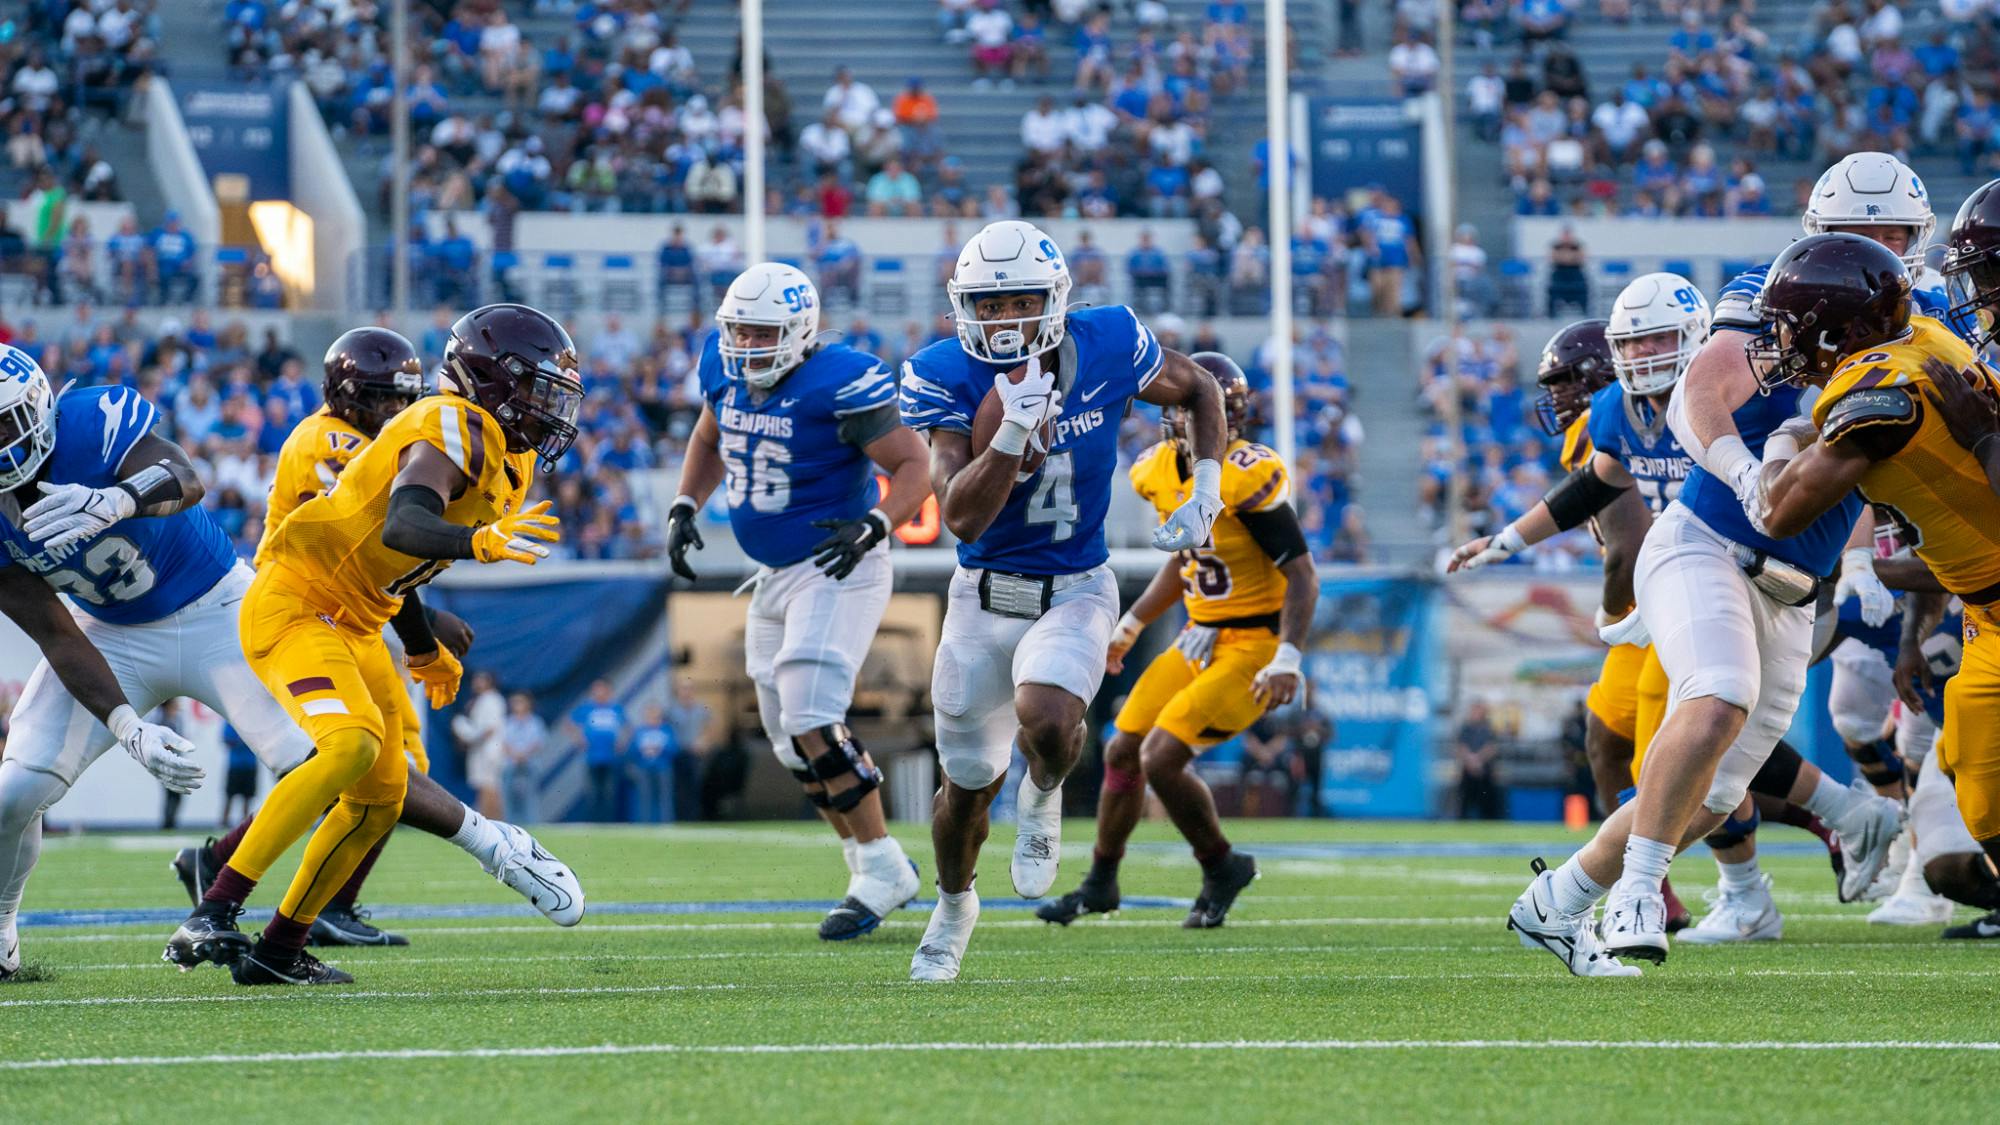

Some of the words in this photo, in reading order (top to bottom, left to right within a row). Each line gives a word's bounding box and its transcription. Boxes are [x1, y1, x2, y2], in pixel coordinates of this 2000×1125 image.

[325, 431, 364, 453] 17
[720, 404, 794, 439] MEMPHIS
[1050, 406, 1106, 447] PHIS
[719, 431, 792, 514] 56
[1025, 450, 1081, 544] 4
[1180, 534, 1232, 600] 5
